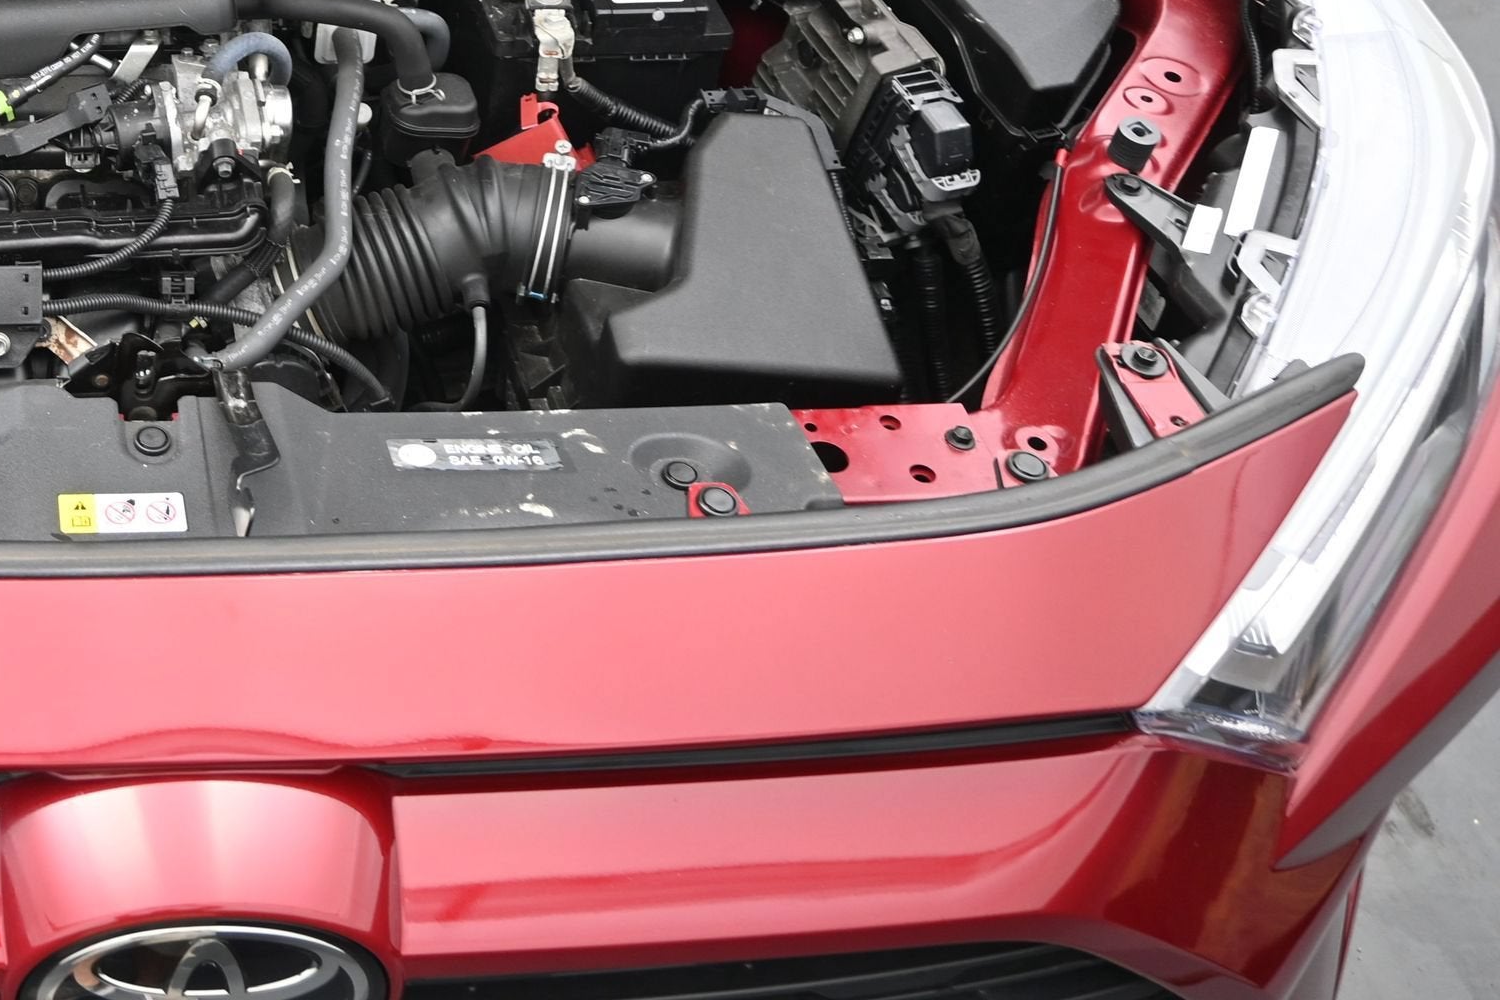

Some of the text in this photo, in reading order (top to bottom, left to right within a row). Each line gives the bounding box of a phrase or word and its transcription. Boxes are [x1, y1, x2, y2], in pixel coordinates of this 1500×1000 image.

[443, 443, 541, 455] ENGINE OIL
[448, 455, 545, 466] SAE 0W-16
